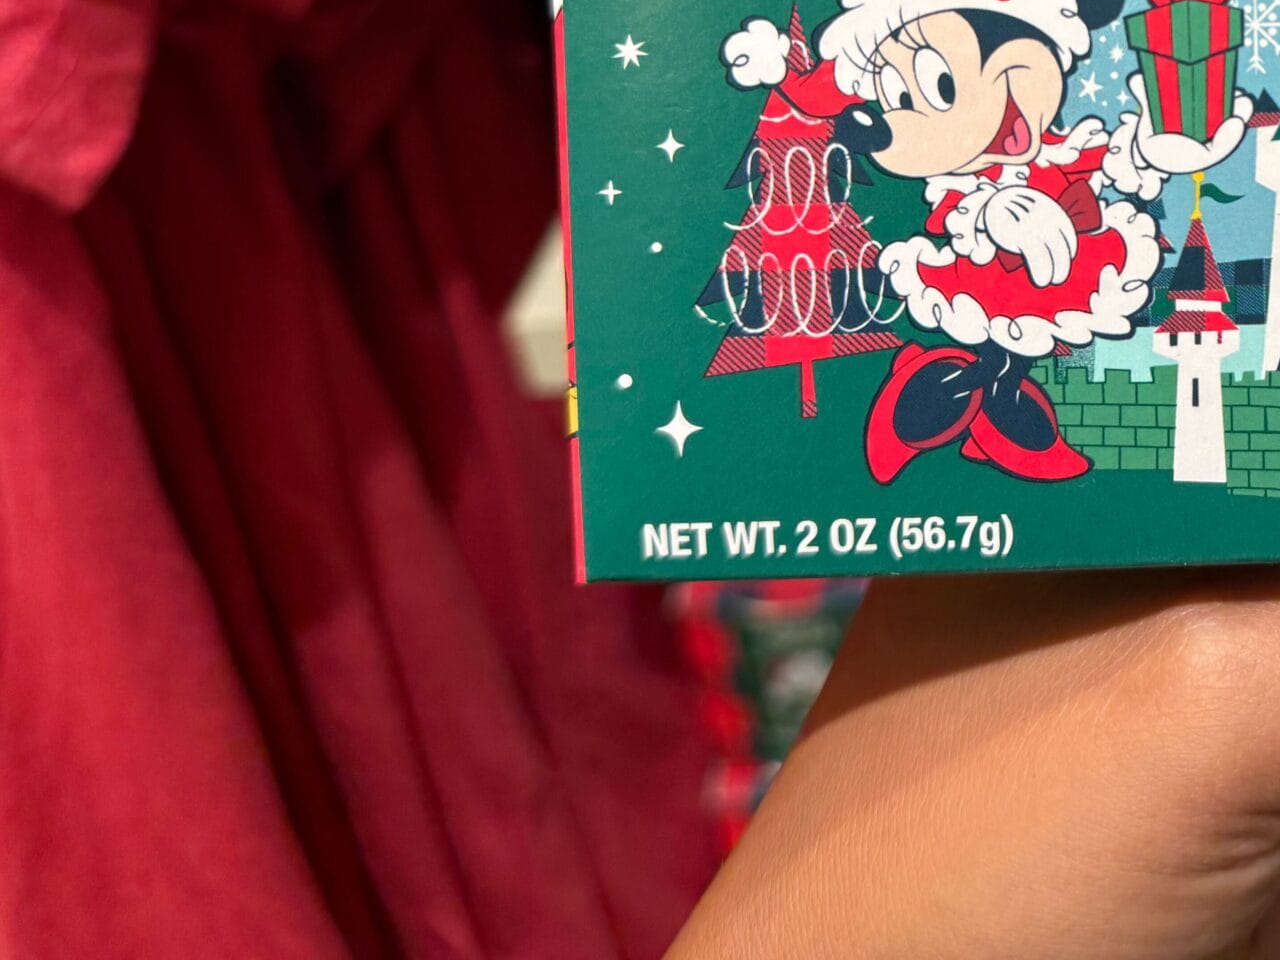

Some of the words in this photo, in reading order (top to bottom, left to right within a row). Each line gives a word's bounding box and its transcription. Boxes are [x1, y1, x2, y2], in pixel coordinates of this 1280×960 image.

[641, 523, 712, 560] NET
[723, 521, 786, 558] WT.
[795, 520, 819, 556] 2
[830, 518, 878, 554] OZ
[889, 514, 1015, 558] (56.7g)
